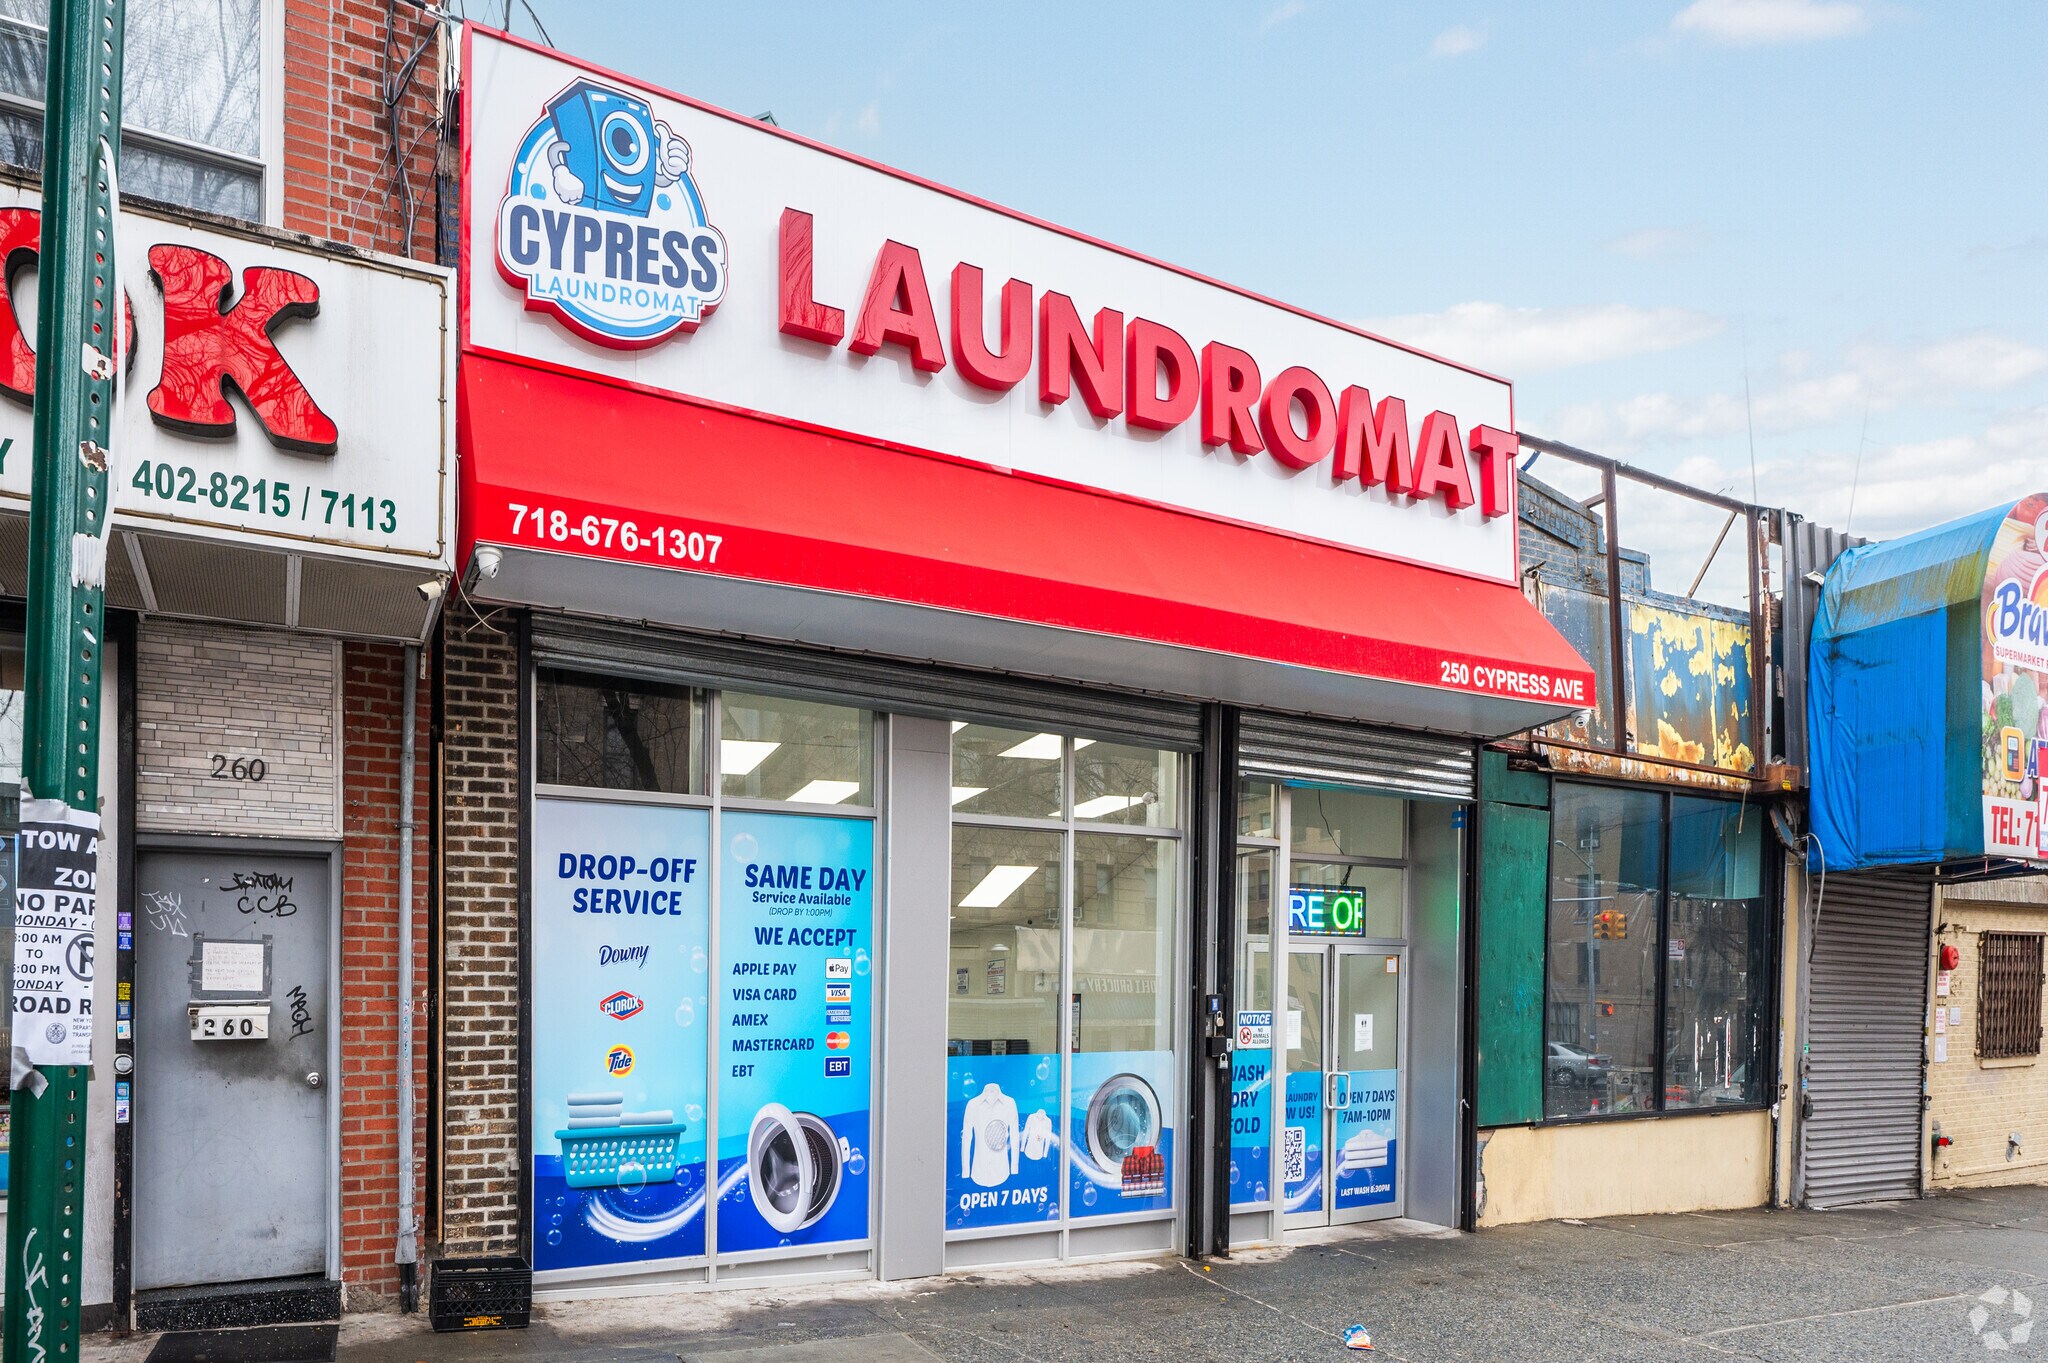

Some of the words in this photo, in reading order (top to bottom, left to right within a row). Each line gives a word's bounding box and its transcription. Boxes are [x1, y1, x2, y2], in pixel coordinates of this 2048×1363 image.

[509, 204, 717, 292] CYPRESS
[535, 273, 699, 314] LAUNDROMAT
[779, 207, 1520, 518] LAUNDROMAT
[132, 460, 291, 518] 402-8215
[320, 490, 397, 534] 7113
[508, 503, 723, 564] 718-676-1307
[1995, 646, 2045, 668] SUPERMARKET
[1441, 661, 1469, 685] 250
[1473, 665, 1550, 697] CYPRESS
[1553, 677, 1584, 700] AVE
[211, 755, 265, 782] 260
[1991, 805, 2020, 846] TEL:
[22, 829, 80, 852] TOW
[558, 853, 697, 883] DROP-OFF
[744, 863, 812, 889] SAME
[819, 866, 866, 892] DAY
[16, 893, 45, 912] NO
[572, 887, 682, 916] SERVICE
[752, 891, 796, 904] Service
[798, 892, 852, 906] Available
[794, 908, 804, 916] BY
[42, 934, 62, 944] AM
[754, 926, 783, 945] WE
[787, 927, 857, 947] ACCEPT
[26, 949, 43, 959] TO
[599, 944, 649, 969] Downy
[41, 965, 60, 975] PM
[732, 963, 770, 976] APPLE
[773, 963, 797, 976] PAY
[835, 964, 849, 975] Pay
[13, 979, 64, 991] ONDAY
[830, 989, 847, 997] VISA
[732, 988, 761, 1001] VISA
[764, 988, 797, 1001] CARD
[604, 996, 640, 1016] CLOROX
[205, 1019, 253, 1037] 260
[732, 1014, 769, 1026] AMEX
[1239, 1013, 1271, 1025] NOTICE
[732, 1038, 815, 1052] MASTERCARD
[608, 1051, 632, 1073] Tide
[732, 1065, 754, 1077] EBT
[829, 1061, 848, 1071] EBT
[1286, 1092, 1318, 1103] LAUNDRY
[1365, 1090, 1371, 1103] 7
[1372, 1089, 1395, 1103] DAYS
[1299, 1106, 1315, 1119] US!
[1342, 1108, 1391, 1123] 7AM-10PM
[1230, 1117, 1261, 1135] OLD
[960, 1191, 998, 1210] OPEN
[1001, 1190, 1009, 1206] 7
[1012, 1186, 1048, 1205] DAYS
[1341, 1188, 1353, 1197] LAST
[1354, 1186, 1370, 1195] WASH
